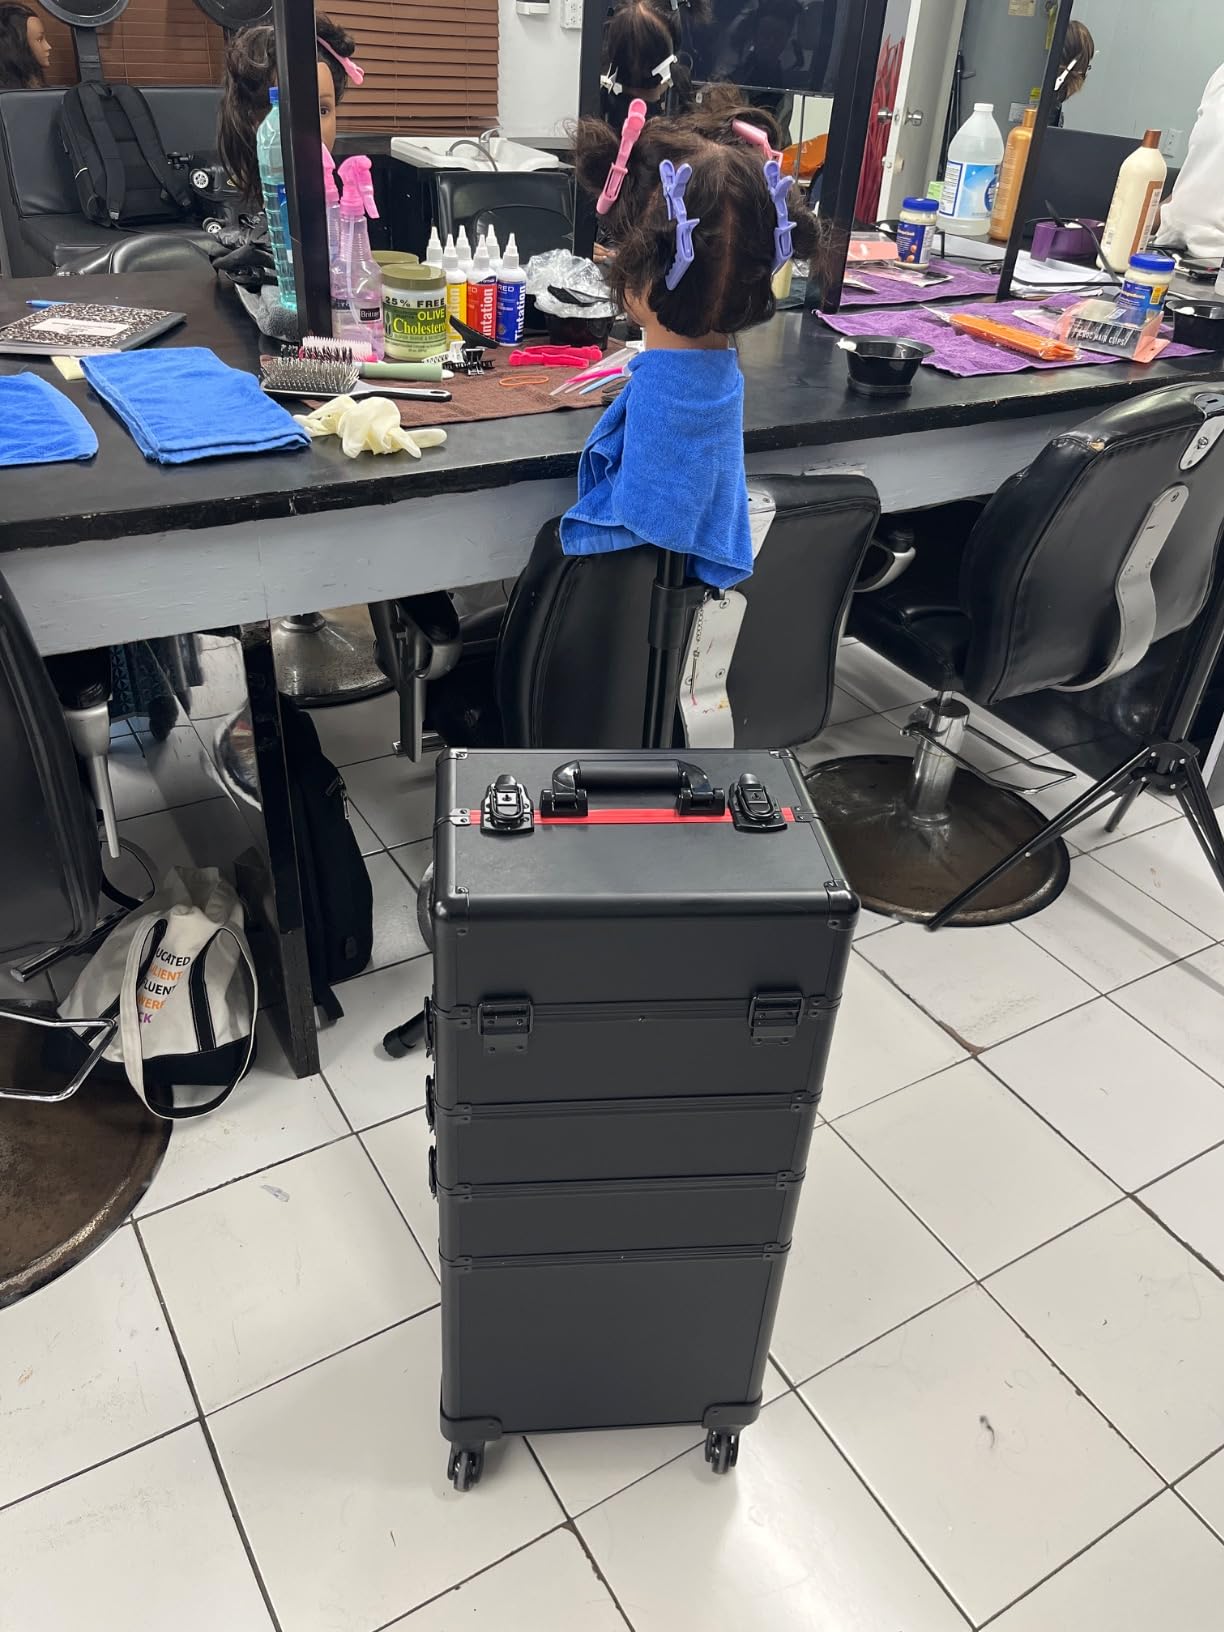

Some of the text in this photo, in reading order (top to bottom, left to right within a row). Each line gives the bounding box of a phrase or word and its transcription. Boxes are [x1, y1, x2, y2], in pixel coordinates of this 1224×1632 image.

[498, 284, 515, 293] RED
[417, 297, 445, 308] FREE
[418, 309, 445, 321] OLIVE
[480, 288, 494, 336] intation
[514, 285, 526, 342] Tintation
[393, 317, 447, 335] Cholestero
[156, 948, 191, 966] UCATED
